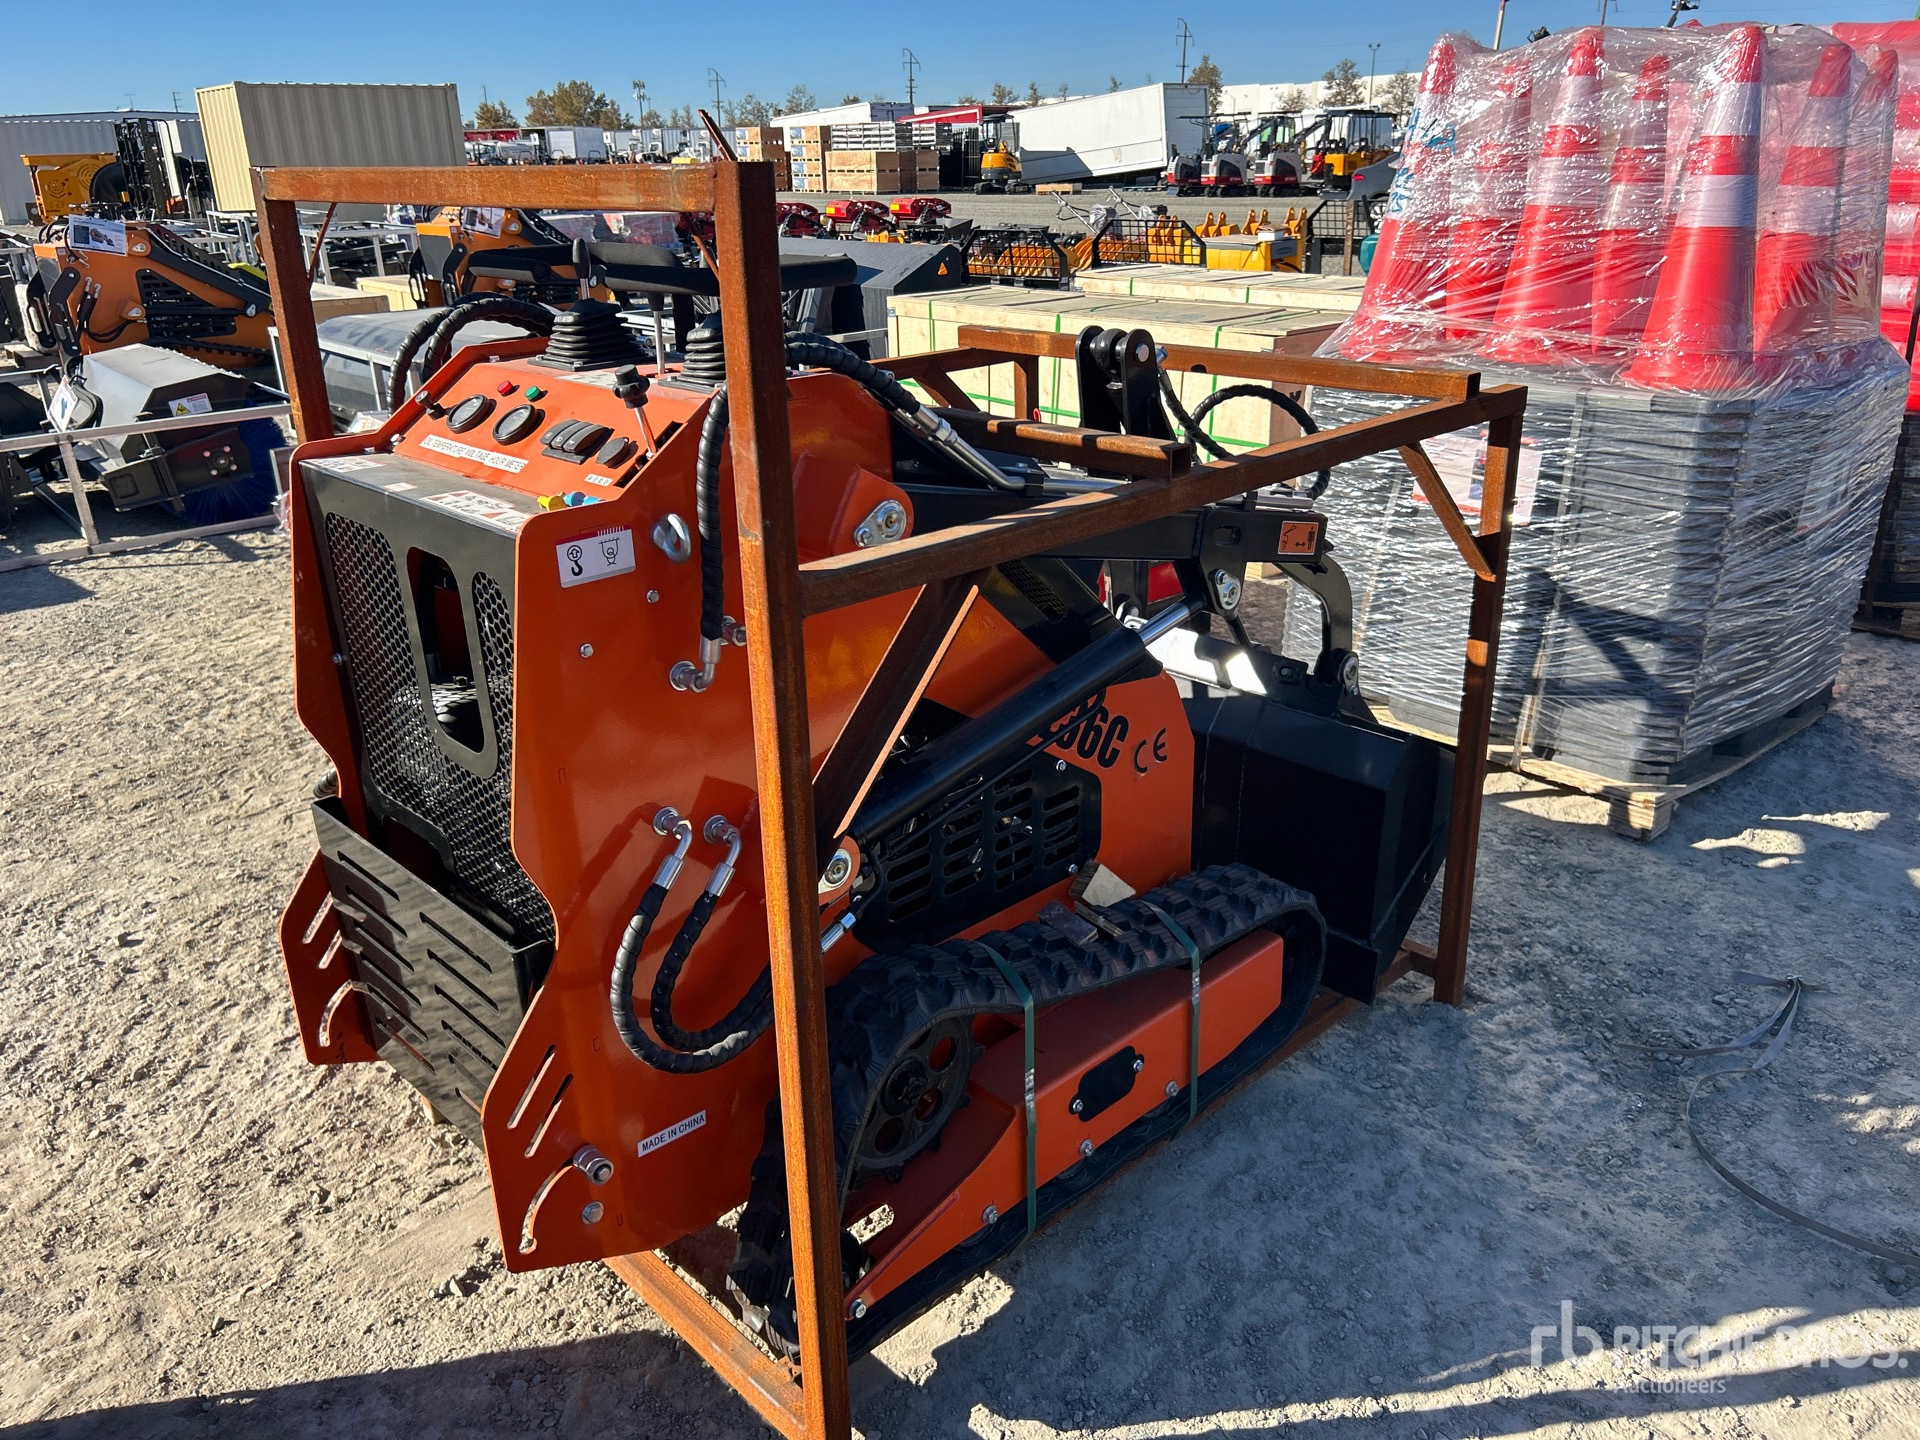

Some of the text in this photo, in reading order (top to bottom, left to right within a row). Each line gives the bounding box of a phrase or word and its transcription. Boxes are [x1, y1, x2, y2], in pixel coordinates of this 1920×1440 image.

[465, 448, 491, 461] VOLTAGE
[489, 456, 507, 466] HOUR
[642, 1115, 704, 1151] MADE IN CHINA
